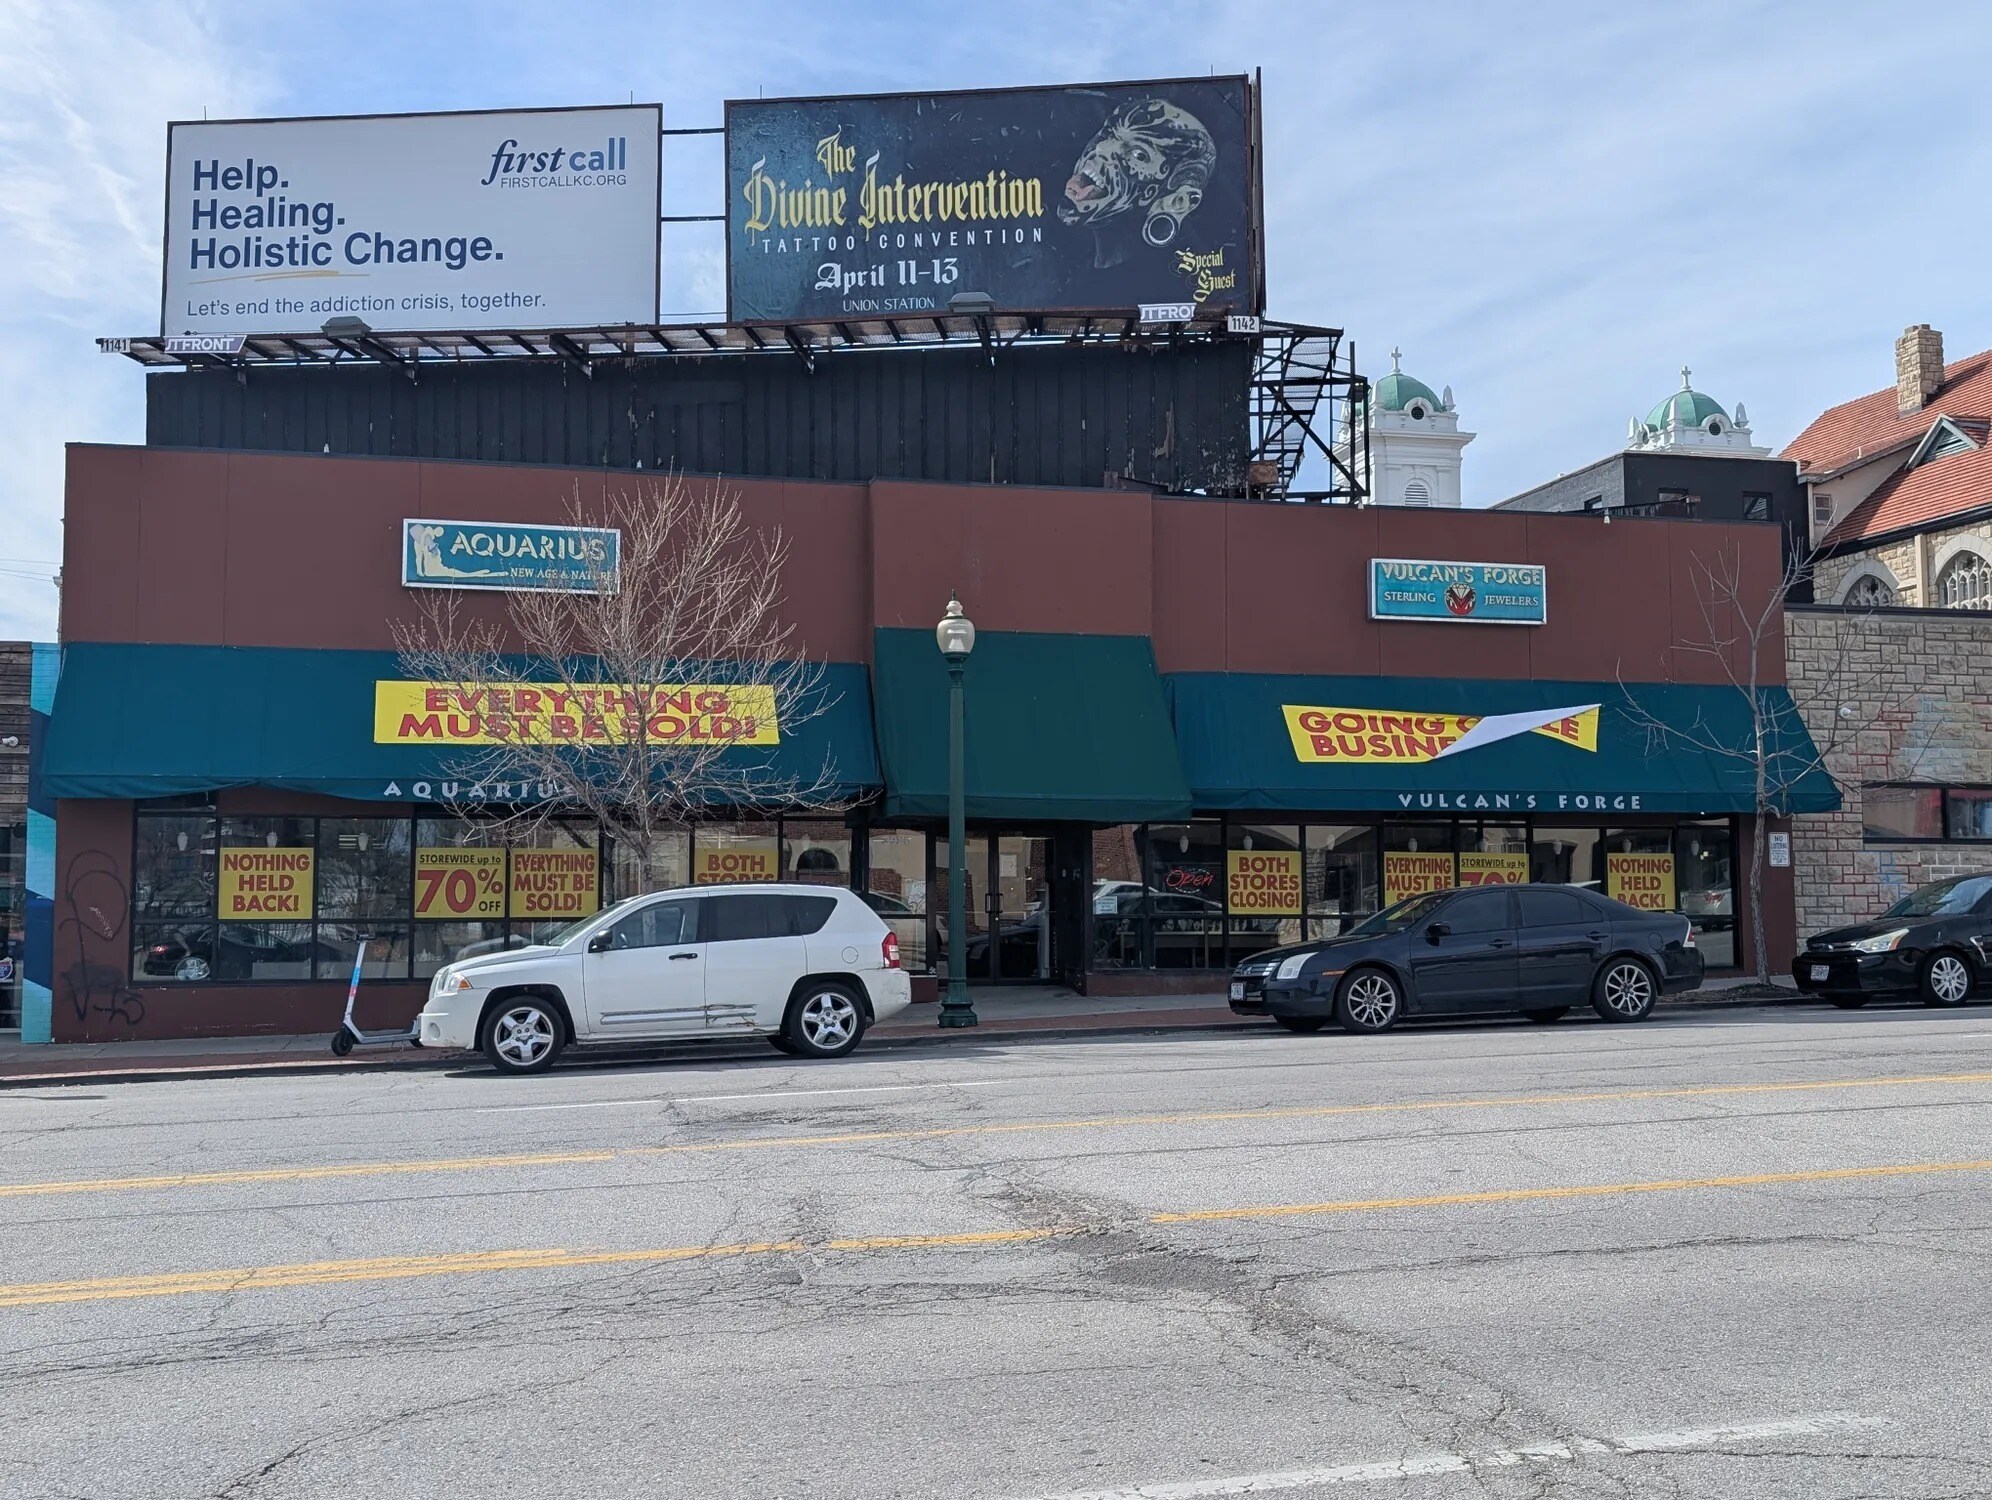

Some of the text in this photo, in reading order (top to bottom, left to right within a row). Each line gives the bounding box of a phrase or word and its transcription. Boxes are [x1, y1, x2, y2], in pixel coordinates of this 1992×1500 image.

[480, 137, 626, 186] first call
[816, 124, 857, 183] The
[193, 158, 289, 198] Help.
[500, 174, 627, 189] FIRSTCALLKC.ORG
[743, 149, 1044, 247] Divine Intervention
[192, 196, 345, 235] Healing.
[762, 227, 1043, 254] TATTOO CONVENTION
[190, 231, 504, 271] Holistic Change.
[1174, 246, 1225, 276] Special
[815, 257, 959, 295] April 11-13
[1192, 267, 1236, 302] Guest
[187, 291, 546, 316] Let's end the addiction crisis, together.
[843, 297, 935, 313] UNION STATION
[1231, 317, 1255, 331] 1142
[103, 338, 128, 351] 1141
[450, 530, 607, 562] AQUARIUS
[510, 567, 534, 578] NEW
[537, 568, 558, 579] AGE
[571, 570, 613, 581] NATRE
[1381, 563, 1541, 586] VULCAN'S FORGE
[1384, 591, 1539, 606] STERLING JEWELERS
[398, 713, 758, 739] MUST BE SOLD!
[1299, 711, 1446, 736] GOING
[383, 781, 578, 800] AQUARIU
[1398, 793, 1640, 810] VULCAN'S FORGE
[1775, 835, 1783, 843] NO
[223, 853, 310, 871] NOTHING
[419, 854, 501, 866] STOREWIDE up to
[514, 854, 595, 872] EVERYTHING
[708, 854, 765, 872] BOTH
[1239, 856, 1289, 873] BOTH
[1386, 857, 1451, 875] EVERYTHING
[1461, 859, 1526, 870] STOREWIDE up to
[1609, 858, 1672, 874] NOTHING
[238, 875, 294, 891] HELD
[514, 874, 595, 891] MUST BE
[1166, 870, 1215, 887] Open
[1230, 874, 1299, 891] STORES
[1386, 875, 1430, 892] MUST
[1434, 875, 1451, 891] BE
[1621, 876, 1661, 891] HELD
[416, 868, 503, 914] 70%
[1230, 891, 1300, 908] CLOSING!
[233, 894, 300, 912] BACK!
[478, 901, 501, 912] OFF
[525, 893, 582, 911] SOLD!
[1617, 893, 1666, 908] BACK!
